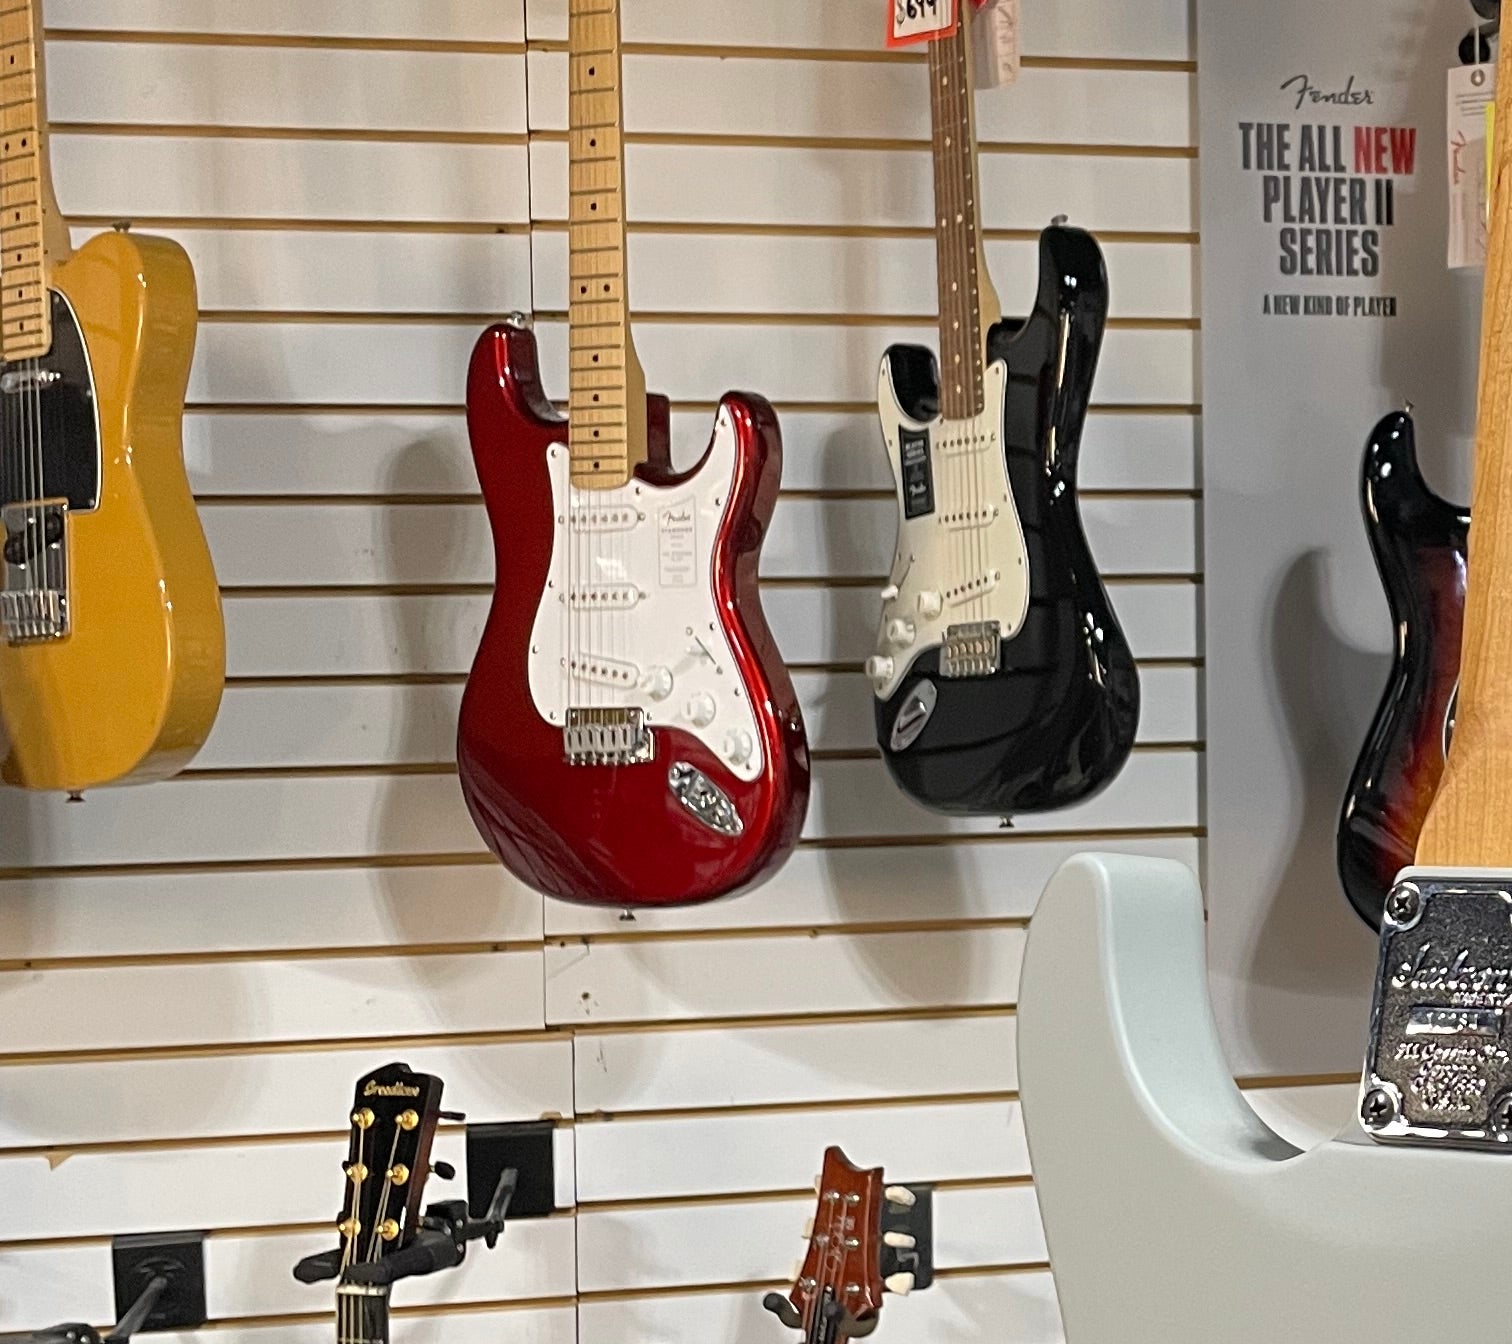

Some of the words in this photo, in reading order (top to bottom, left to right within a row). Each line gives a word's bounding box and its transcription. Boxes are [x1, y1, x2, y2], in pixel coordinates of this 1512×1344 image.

[1280, 74, 1375, 110] Fender
[1238, 122, 1291, 172] THE
[1298, 124, 1347, 173] ALL
[1353, 126, 1417, 175] NEW
[1262, 175, 1368, 226] PLAYER
[1375, 178, 1394, 226] II
[1279, 227, 1379, 277] SERIES
[1262, 294, 1271, 316] A
[1273, 294, 1300, 316] NEW
[1303, 294, 1333, 317] KIND
[1335, 295, 1349, 317] OF
[1353, 295, 1397, 317] PLAYER
